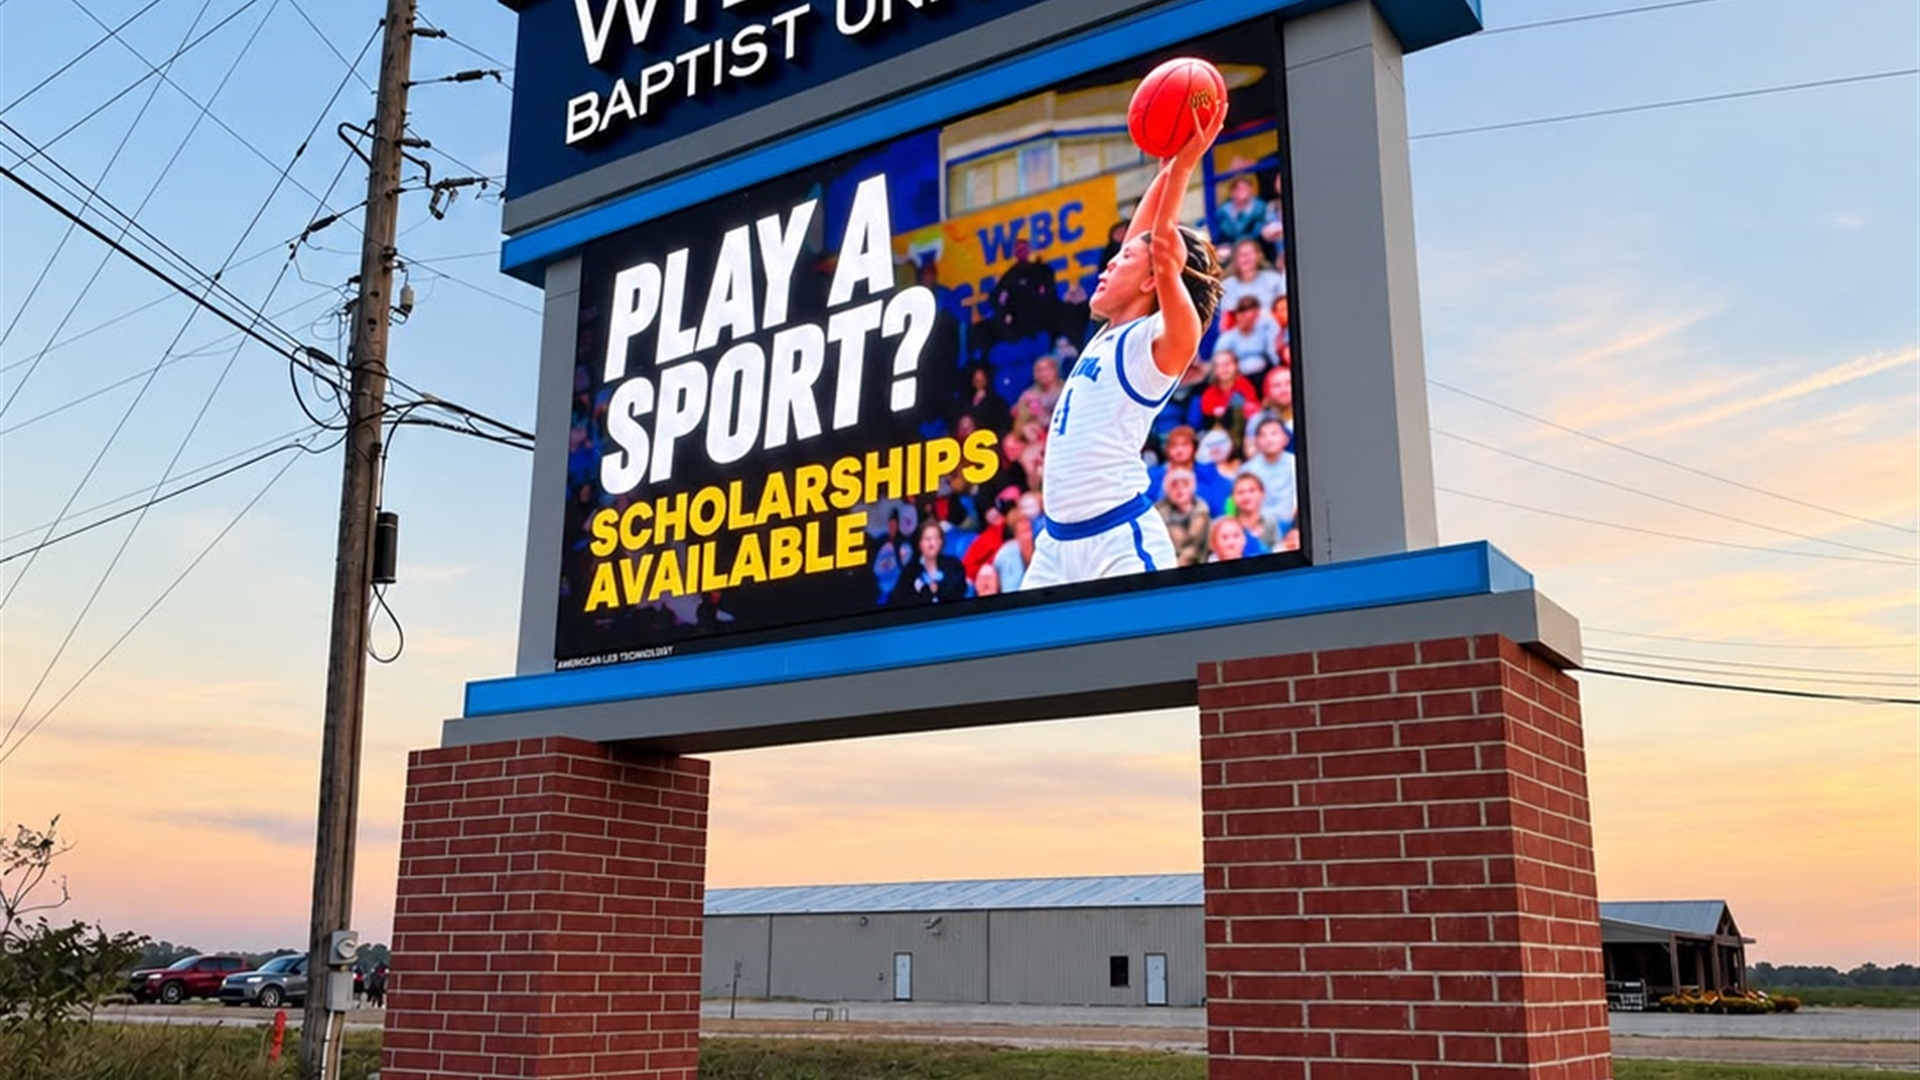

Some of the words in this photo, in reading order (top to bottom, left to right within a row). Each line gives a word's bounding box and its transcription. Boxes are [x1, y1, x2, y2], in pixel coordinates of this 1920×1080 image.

[565, 3, 811, 145] BAPTIST
[603, 198, 819, 384] PLAY
[827, 173, 895, 307] A
[977, 200, 1085, 266] WBC
[600, 285, 937, 495] SPORT?
[590, 429, 999, 557] SCHOLARSHIPS
[584, 511, 867, 612] AVAILABLE
